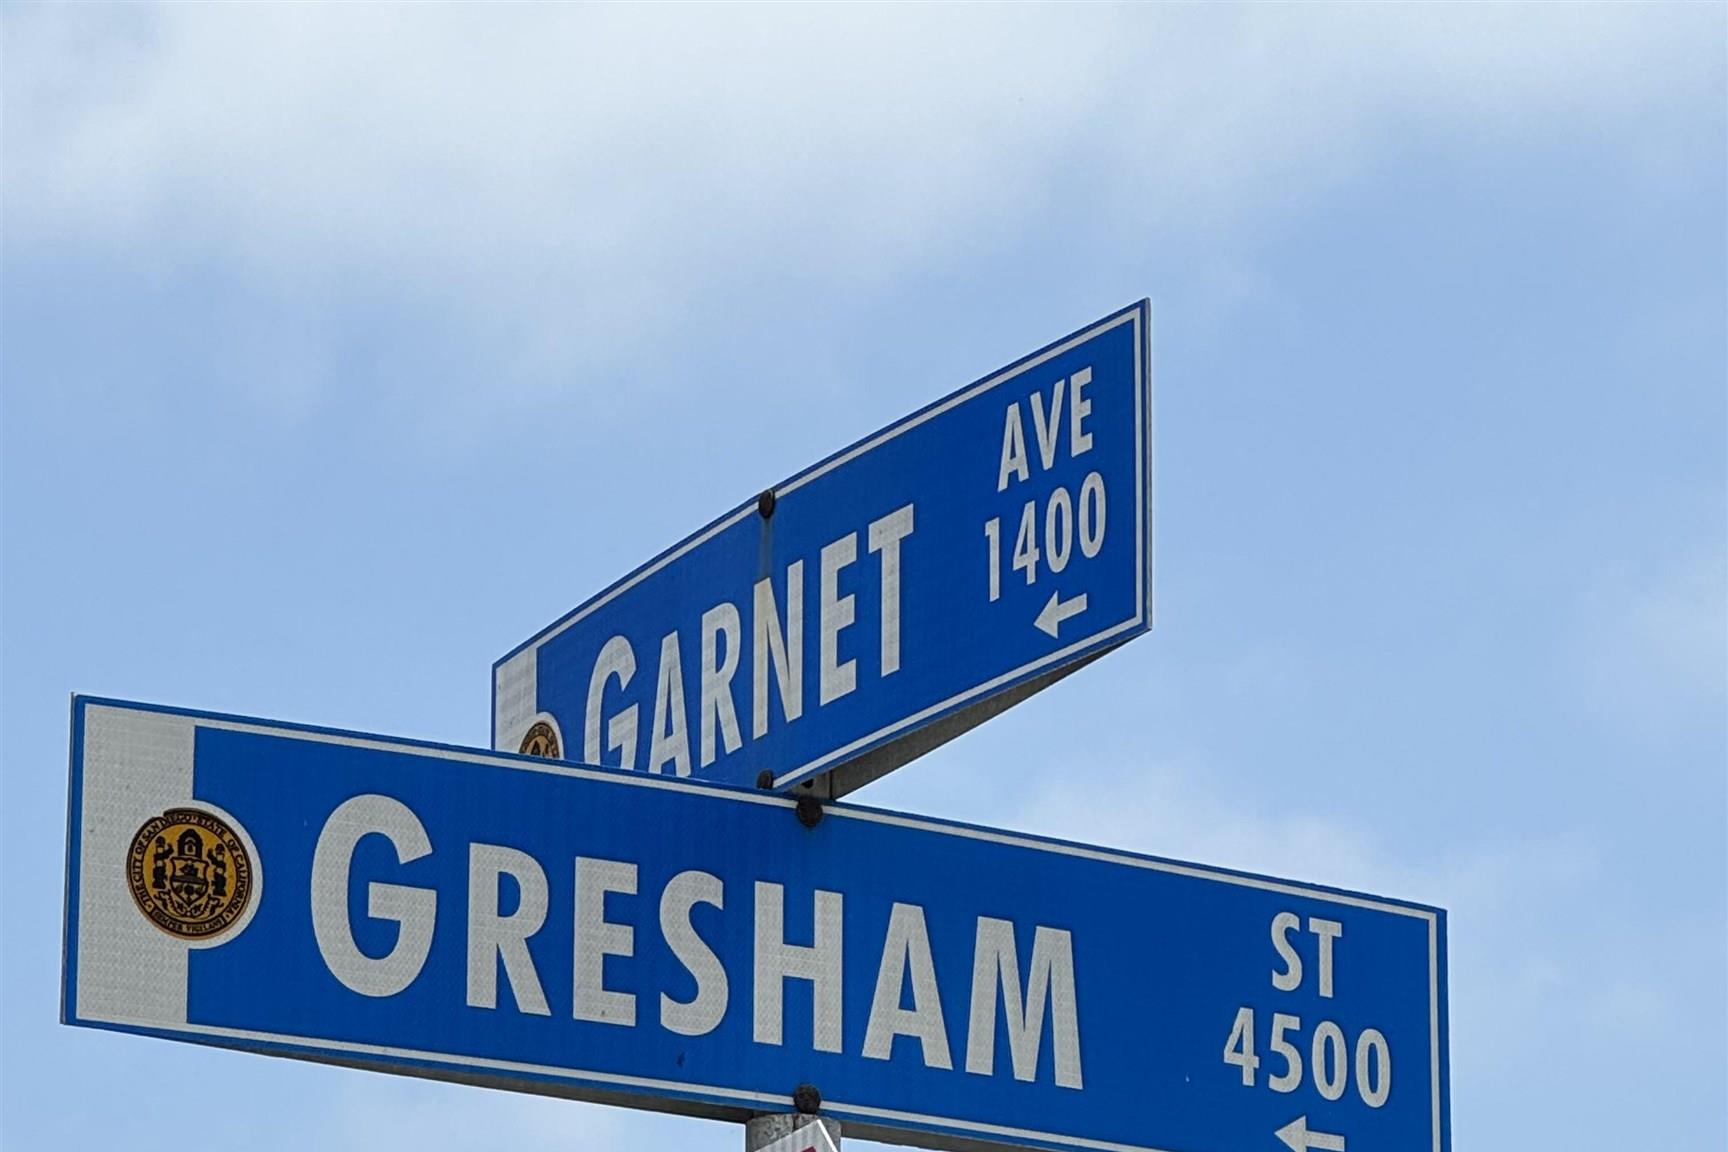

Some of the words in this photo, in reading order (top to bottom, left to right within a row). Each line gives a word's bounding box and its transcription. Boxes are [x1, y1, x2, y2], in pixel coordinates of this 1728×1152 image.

[998, 366, 1093, 492] AVE
[984, 471, 1106, 602] 1400
[584, 503, 914, 778] GARNET
[132, 856, 143, 882] CITY
[310, 793, 1084, 1090] GRESHAM
[1270, 912, 1342, 998] ST
[1223, 1007, 1391, 1108] 4500
